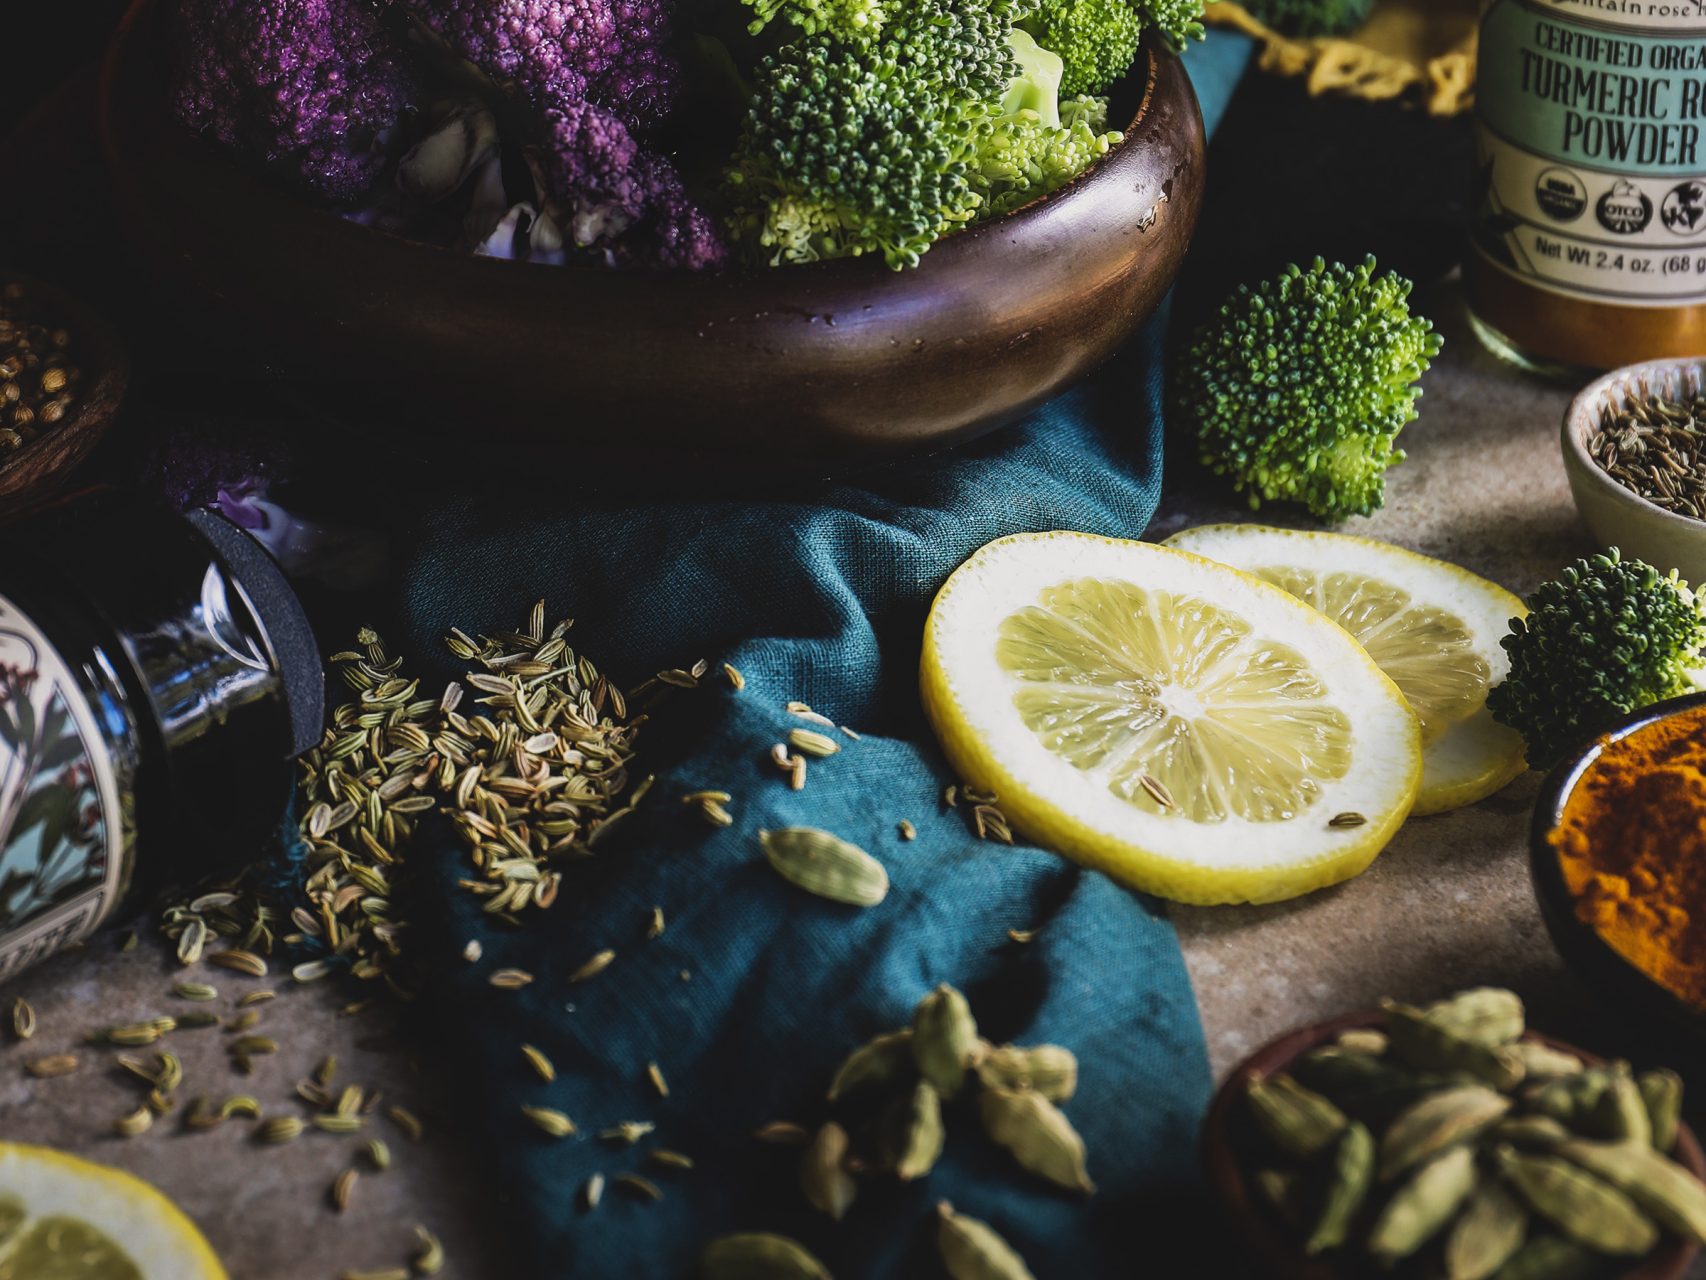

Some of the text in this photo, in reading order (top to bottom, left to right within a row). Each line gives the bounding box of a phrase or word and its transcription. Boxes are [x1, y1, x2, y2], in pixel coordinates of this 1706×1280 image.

[1648, 4, 1691, 17] rose
[1536, 22, 1643, 69] CERTIFIED
[1521, 48, 1706, 120] TURMERIC R
[1563, 110, 1699, 166] POWDER
[1606, 204, 1643, 219] OTCO
[1535, 236, 1562, 259] Net
[1568, 244, 1590, 266] Wt
[1596, 251, 1624, 270] 2.4
[1631, 260, 1654, 273] oz.
[1662, 255, 1690, 276] (68
